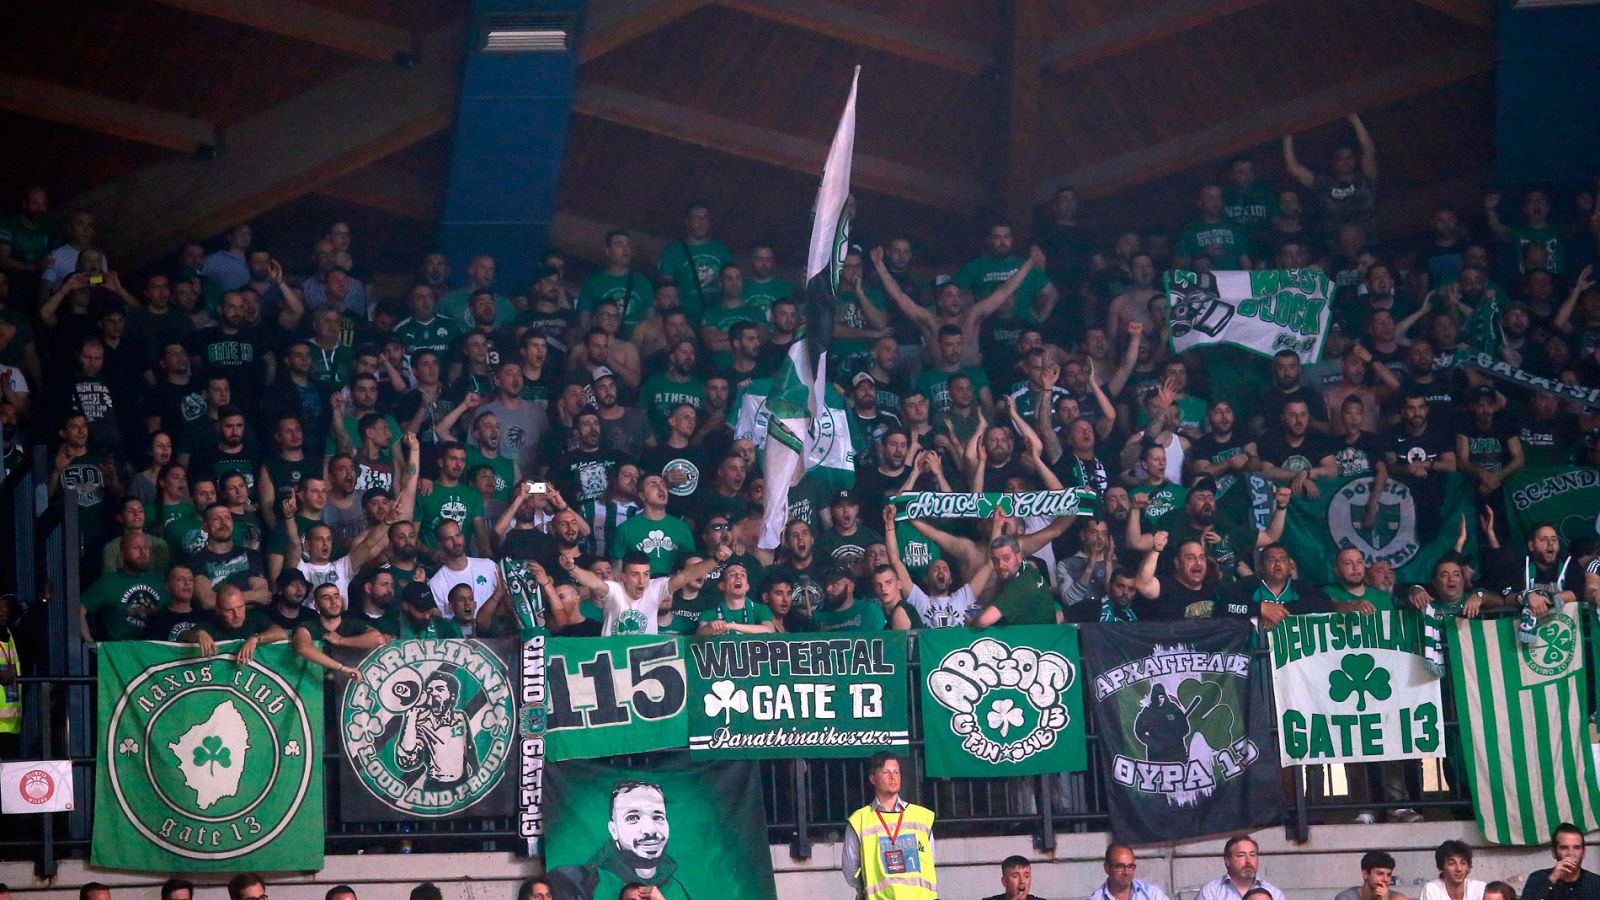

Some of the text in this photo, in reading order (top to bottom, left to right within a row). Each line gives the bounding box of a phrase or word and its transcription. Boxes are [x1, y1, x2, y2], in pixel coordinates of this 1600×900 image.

[1249, 268, 1329, 300] WEST
[655, 392, 700, 408] ATHENS
[906, 488, 1081, 519] Argos Club
[1512, 469, 1600, 511] SCAND
[1227, 603, 1248, 615] 1966
[350, 639, 508, 711] PARALIMNI
[691, 638, 895, 679] WUPPERTAL
[928, 638, 1074, 715] ARGOS
[137, 663, 286, 715] naxos club
[752, 683, 883, 720] GATE 13
[450, 725, 465, 738] 13
[709, 726, 858, 749] Panathinaikos
[963, 731, 1001, 762] FAN
[1011, 728, 1056, 761] CLUB
[1039, 705, 1070, 730] 13
[1282, 701, 1440, 760] GATE 13
[357, 737, 506, 805] LOUD AND PROUD
[1112, 754, 1216, 793] ΘΥΡΑ
[158, 815, 263, 847] gate 13
[908, 856, 916, 870] 1
